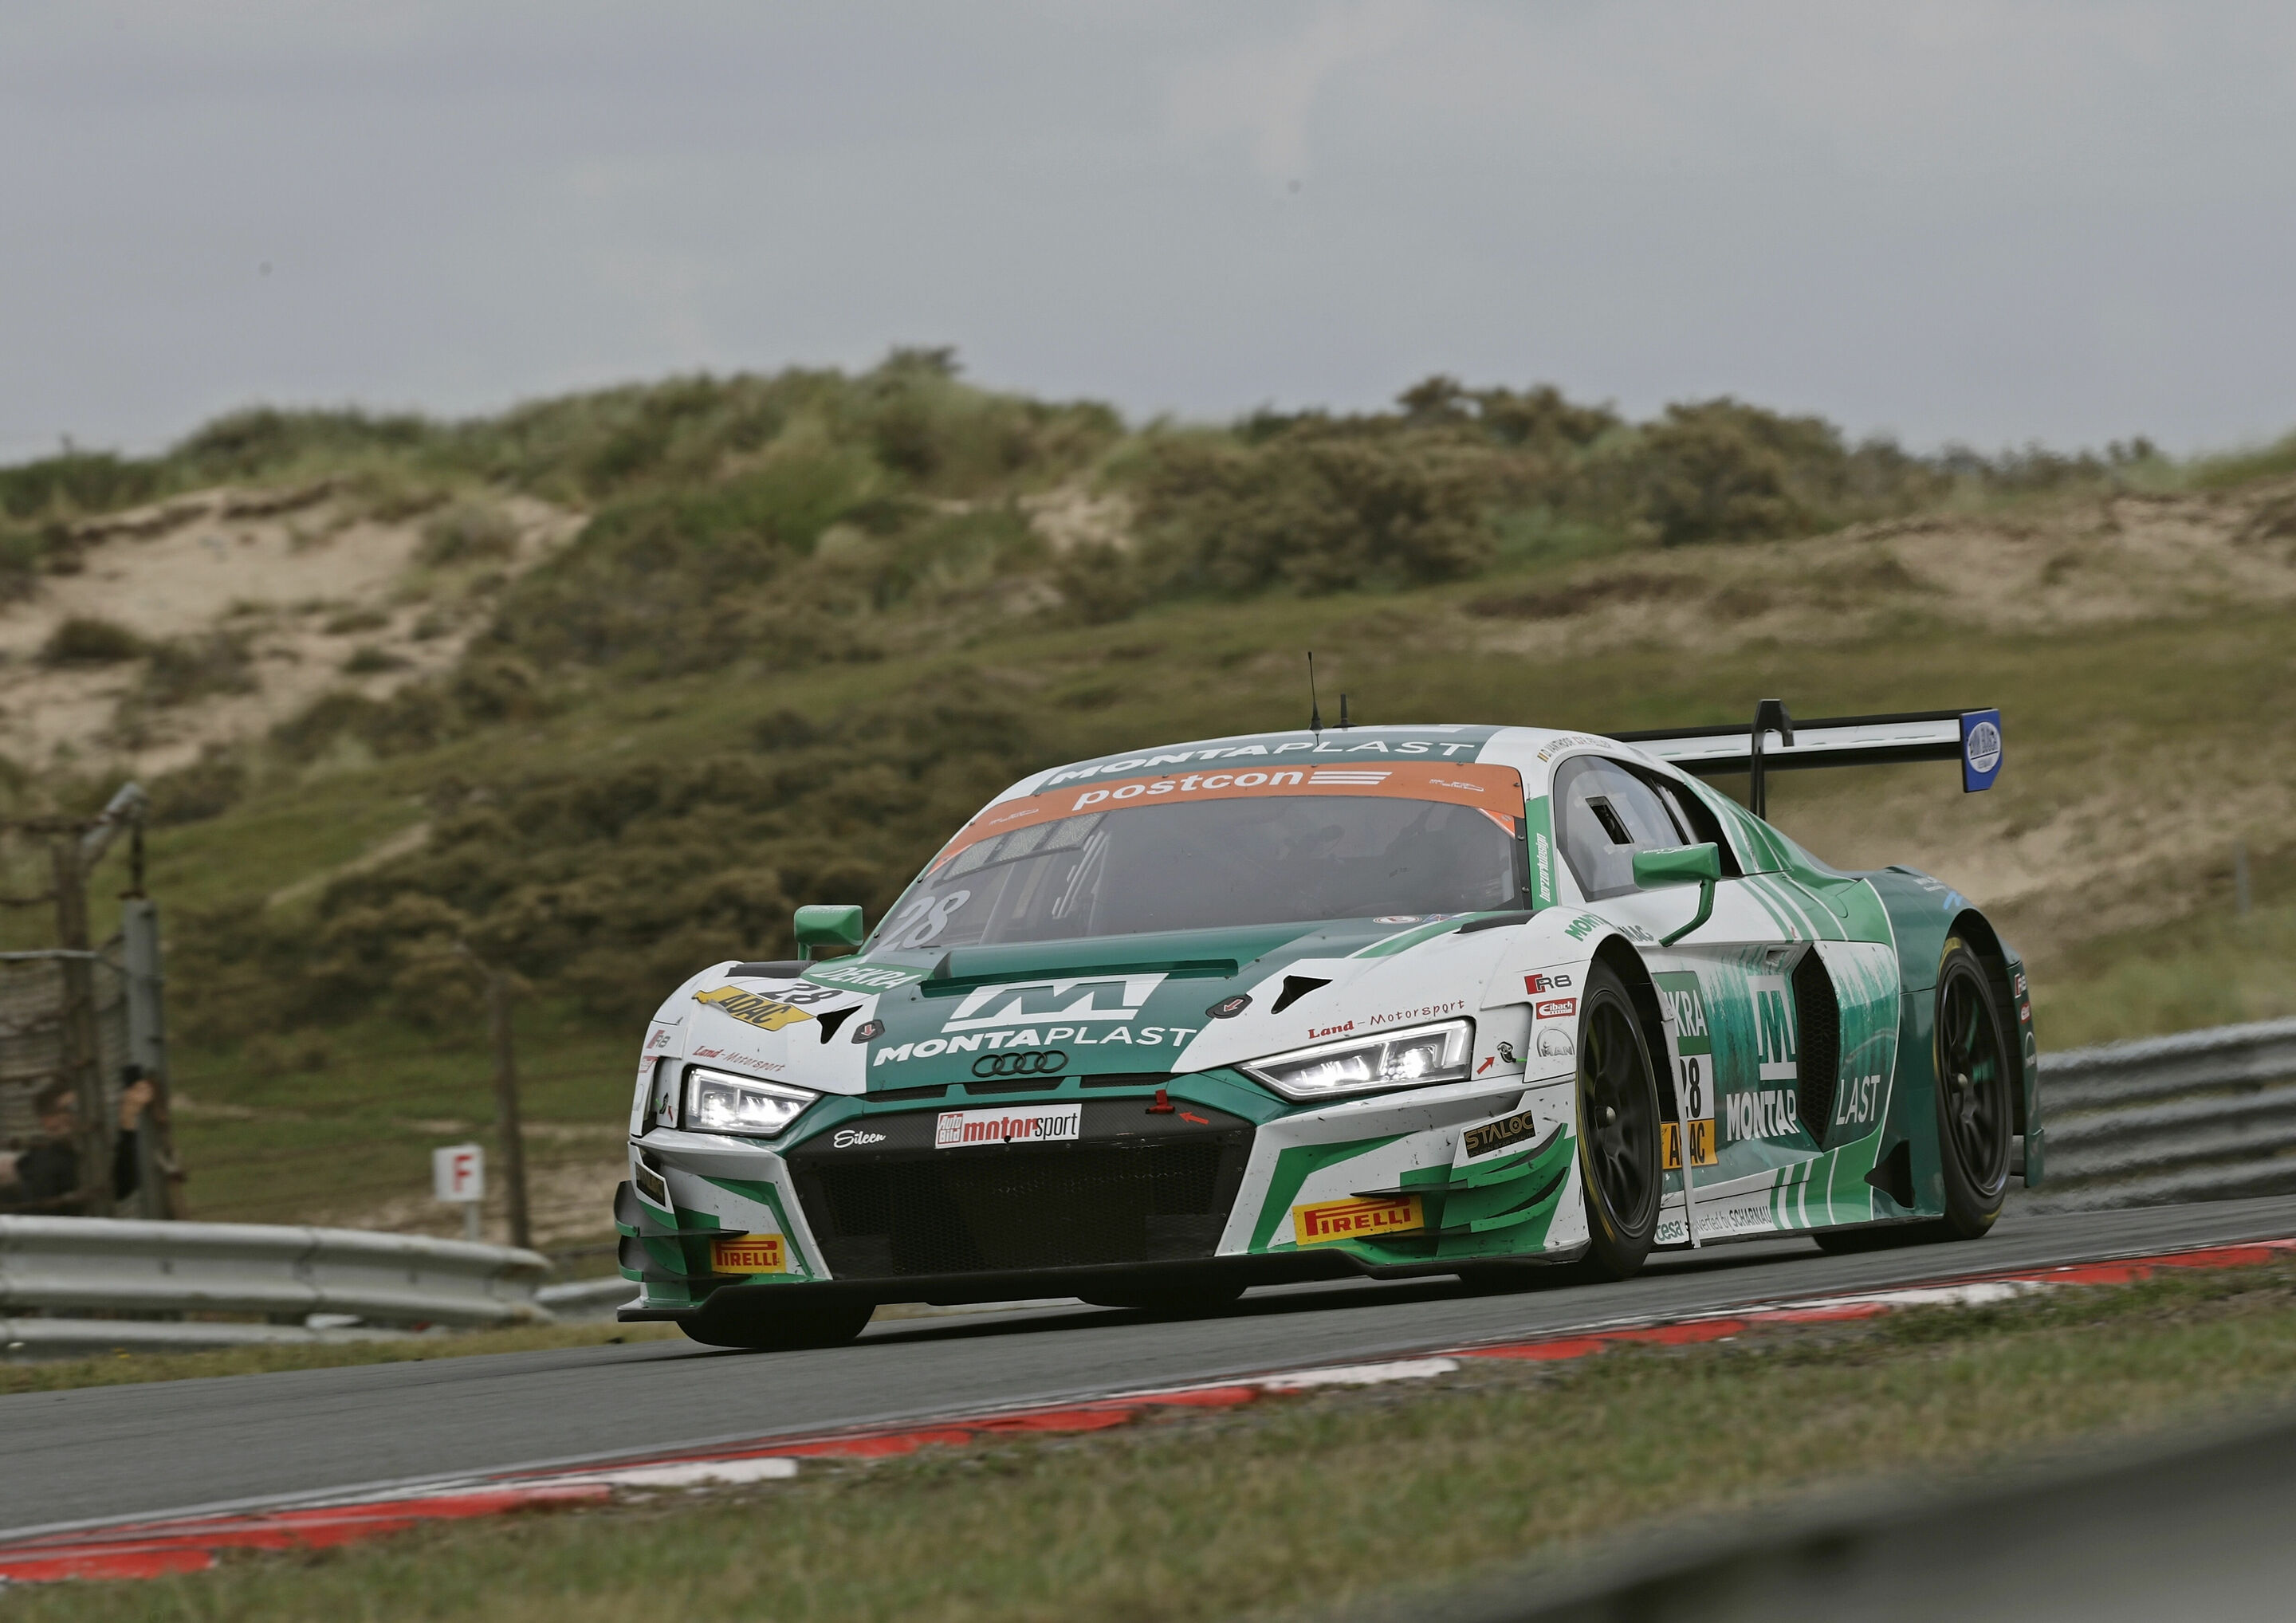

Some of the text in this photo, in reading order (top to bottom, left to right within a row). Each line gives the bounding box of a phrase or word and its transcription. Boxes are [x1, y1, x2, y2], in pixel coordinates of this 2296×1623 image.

[1048, 740, 1475, 785] MONTAPLAST
[1071, 769, 1301, 810] postcon
[875, 890, 971, 952] 28
[757, 983, 843, 1004] 28
[810, 967, 922, 989] DEKRA
[1535, 974, 1572, 991] R8
[718, 993, 791, 1024] ADAC
[1539, 1001, 1573, 1016] Eibach
[1664, 989, 1708, 1037] KRA
[873, 1027, 1197, 1067] MONTAPLAST
[834, 1129, 887, 1149] Eileen
[938, 1129, 961, 1143] Bild
[939, 1115, 963, 1130] Auto
[1464, 1111, 1534, 1149] STALOC
[1669, 1122, 1705, 1167] AAC
[453, 1154, 474, 1193] F
[1303, 1197, 1412, 1236] PIRELLI
[718, 1240, 778, 1267] PIRELLI
